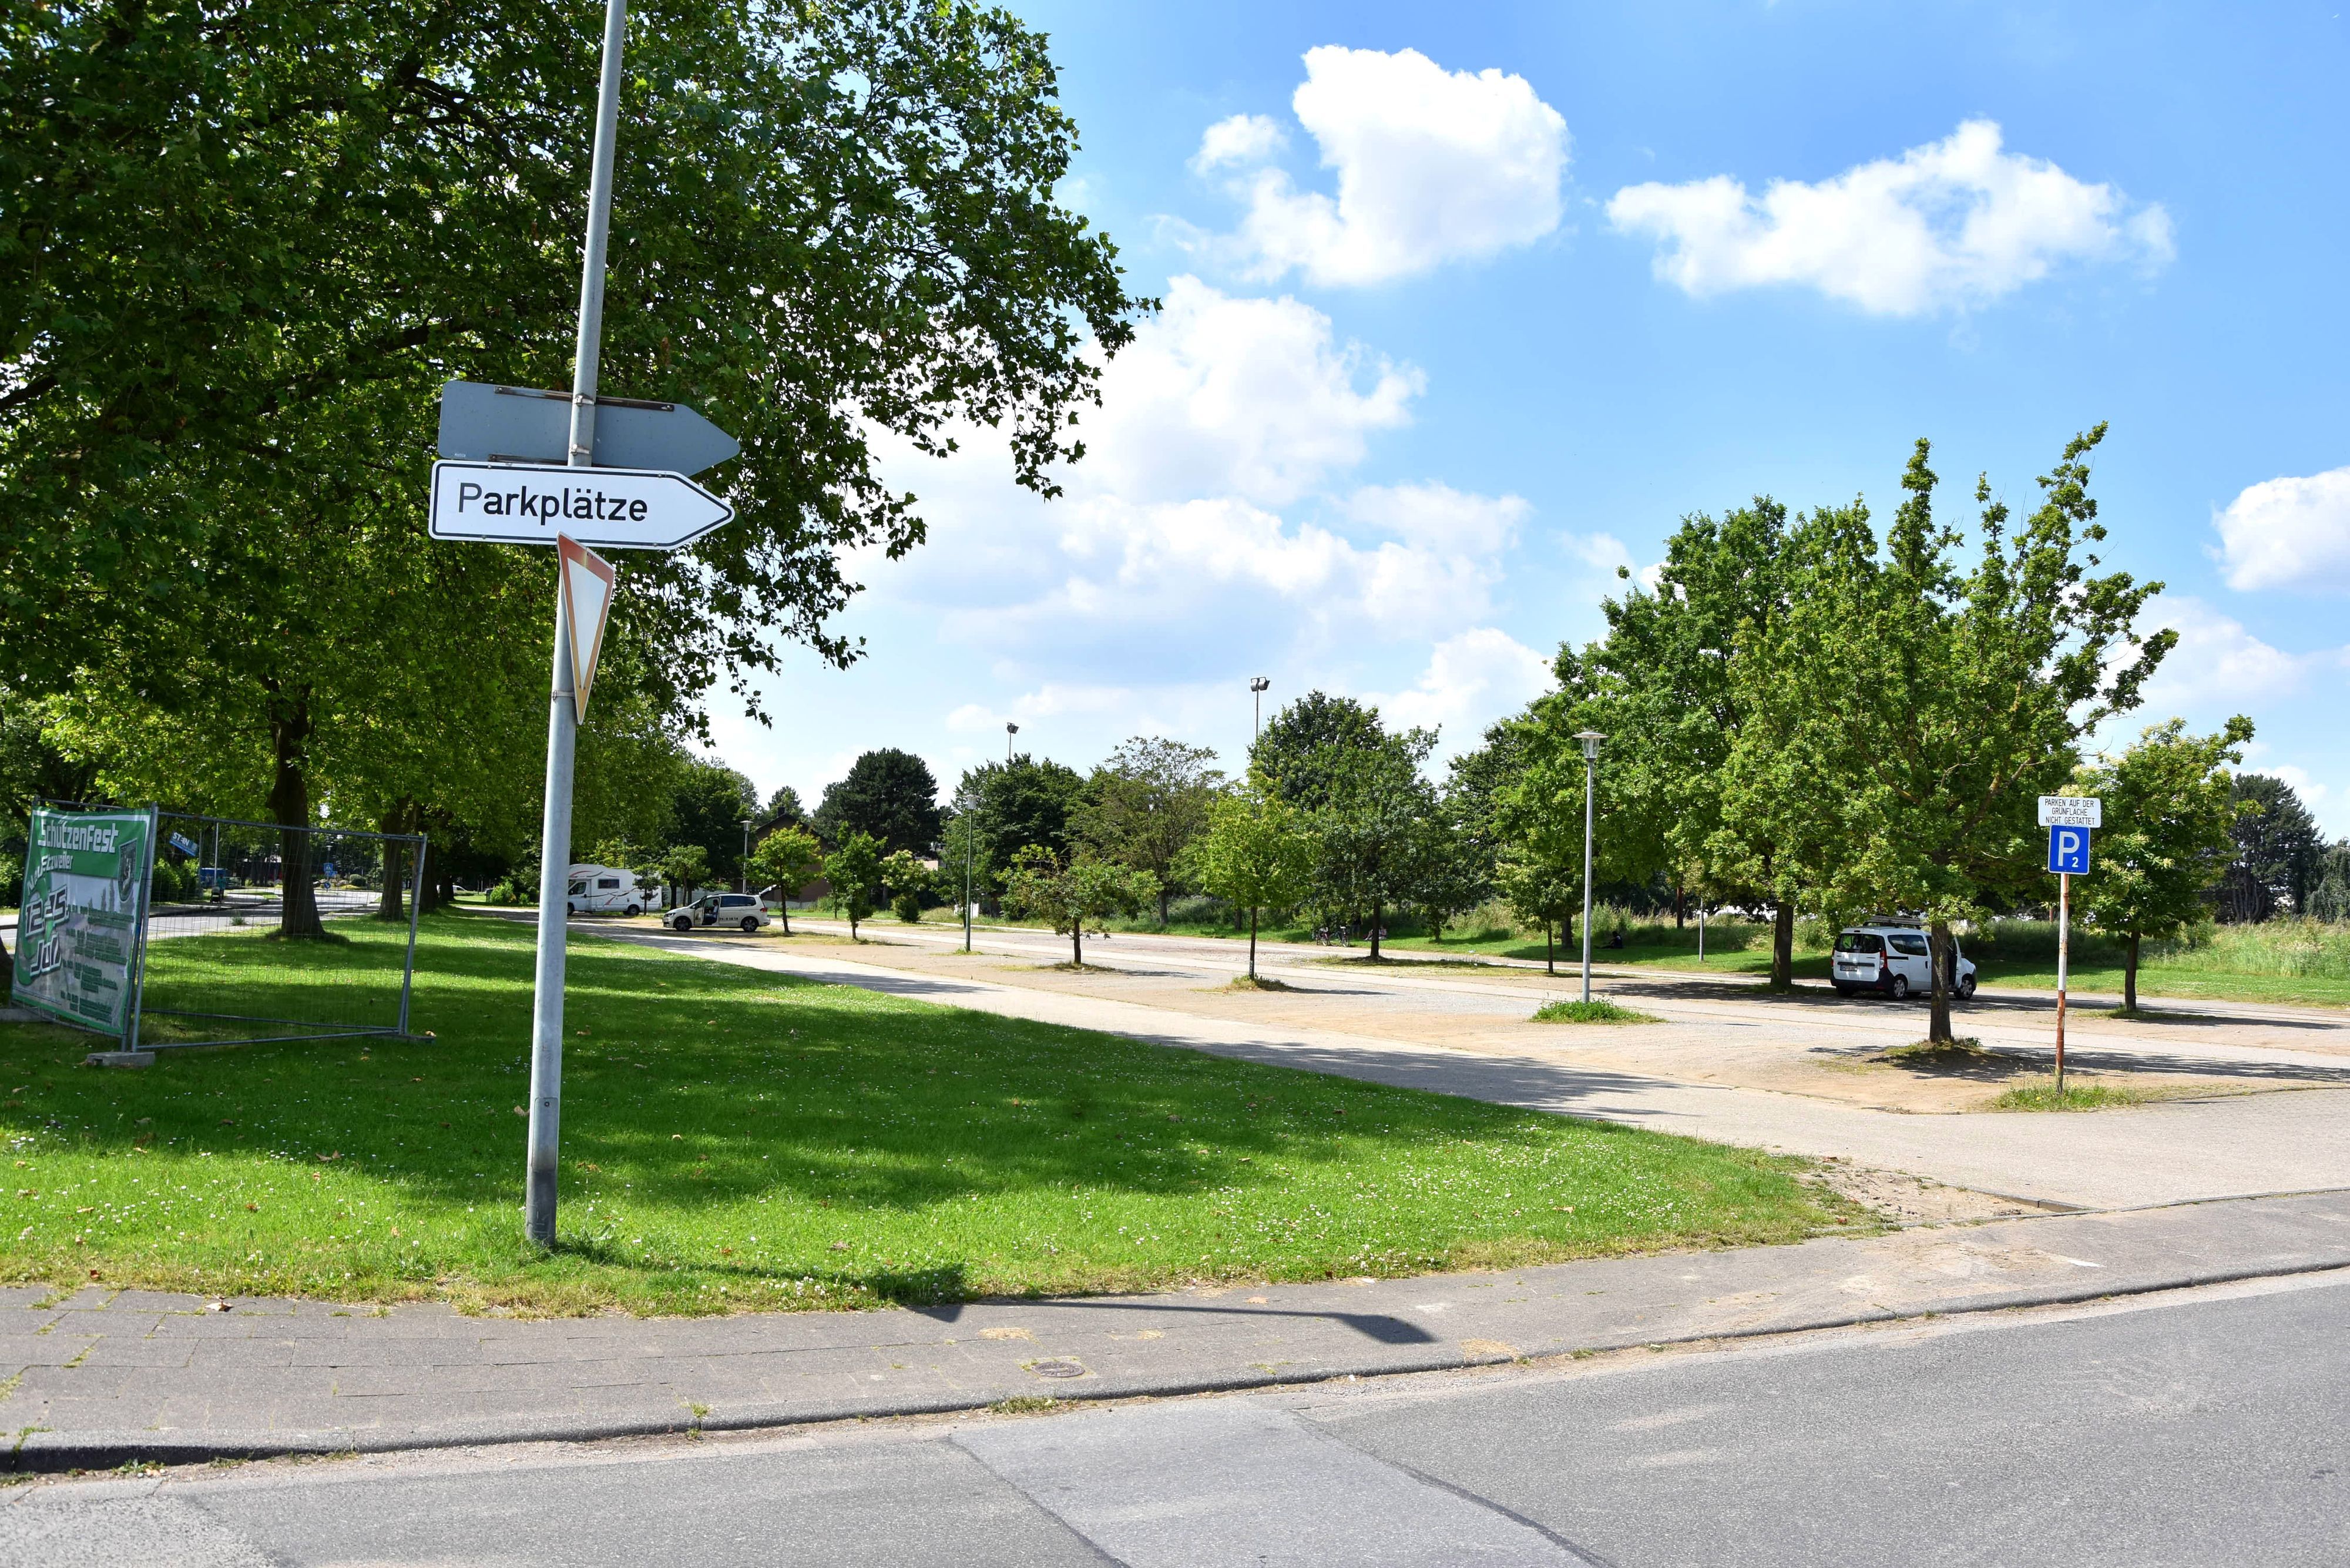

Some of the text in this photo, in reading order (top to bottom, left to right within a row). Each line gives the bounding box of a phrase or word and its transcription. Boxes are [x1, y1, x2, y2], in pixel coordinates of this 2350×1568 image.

[458, 482, 648, 526] Parkplätze
[2044, 798, 2066, 807] PARKEN
[2052, 807, 2087, 816] GRÜNFLÄCHE
[2046, 816, 2095, 825] NICHT GESTATTET
[2058, 831, 2080, 868] P 2
